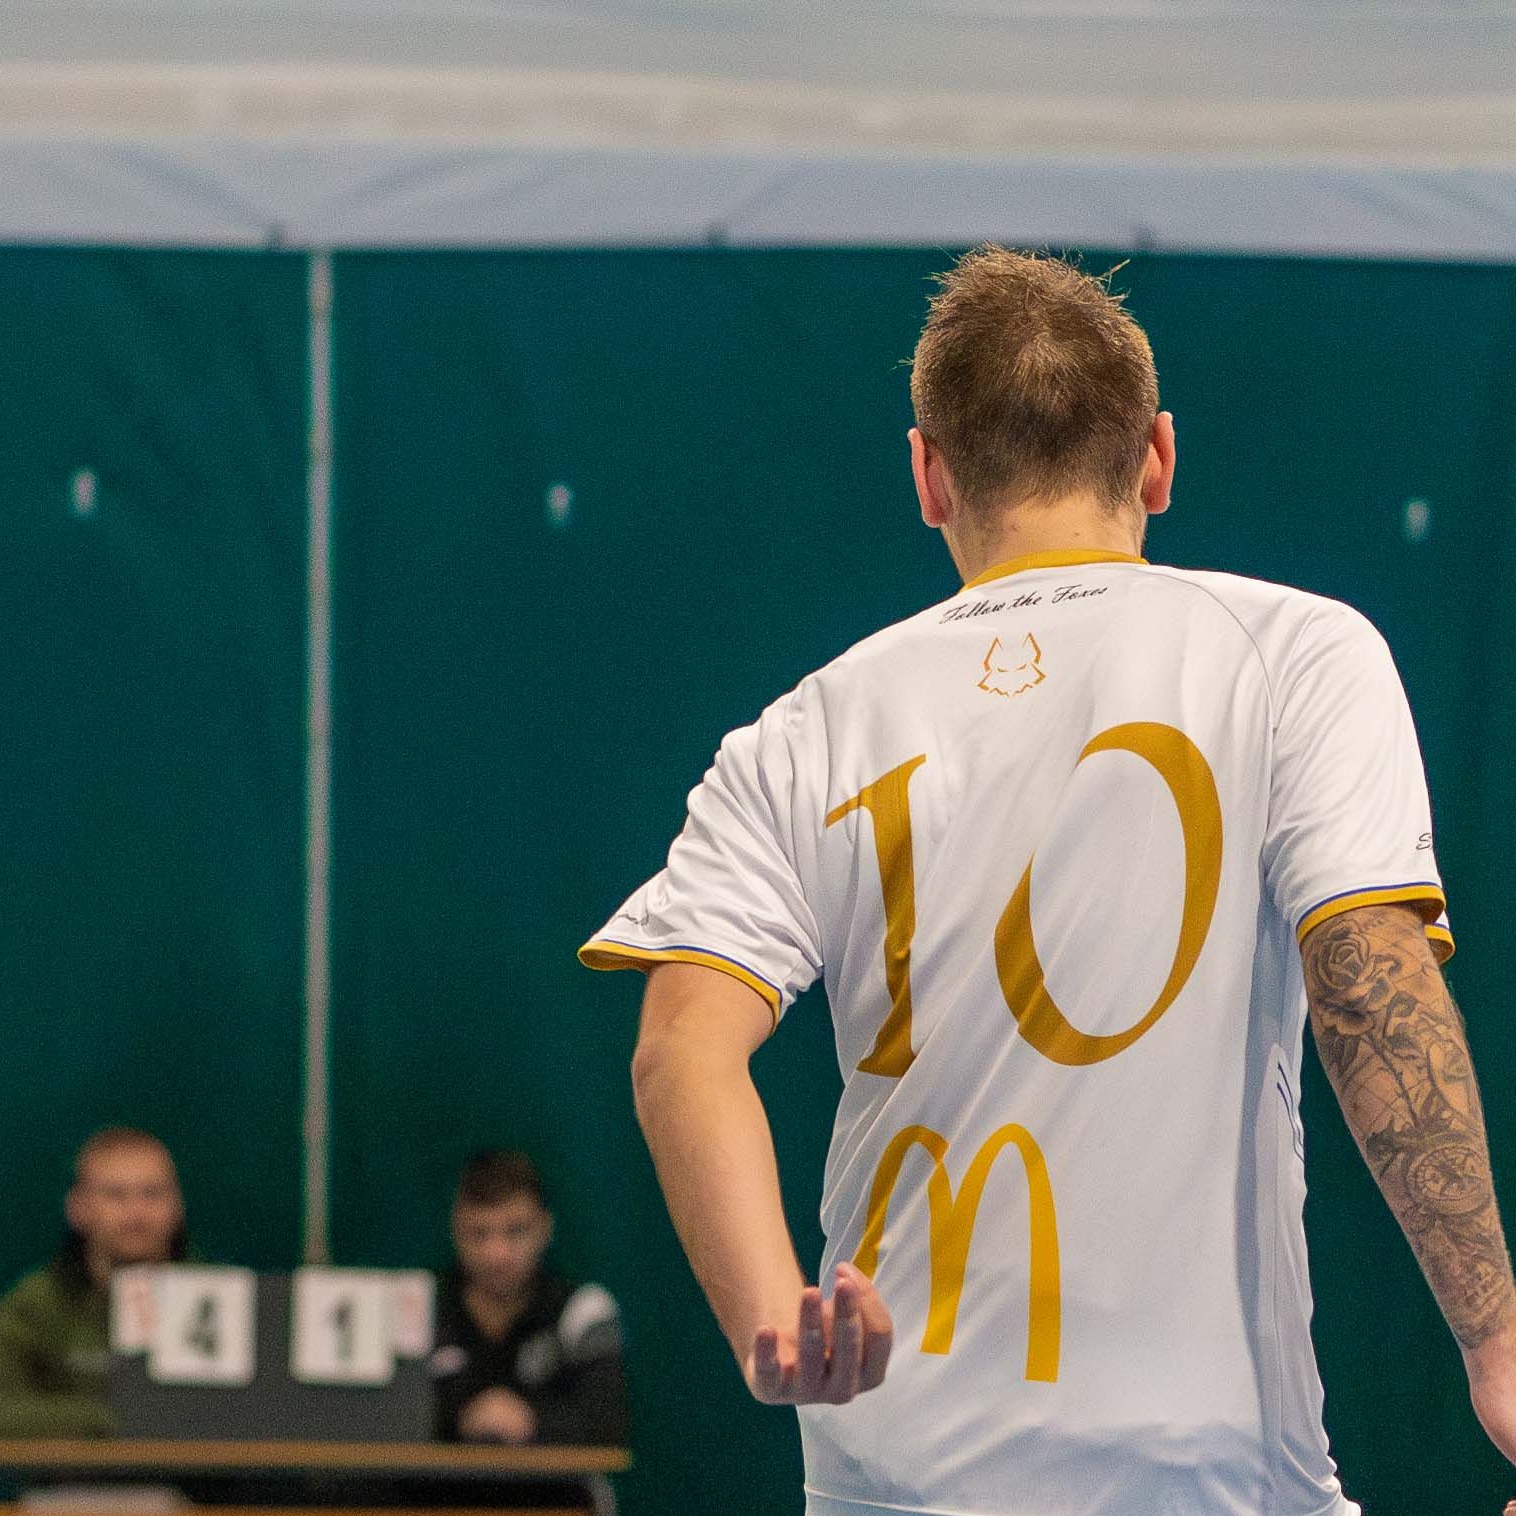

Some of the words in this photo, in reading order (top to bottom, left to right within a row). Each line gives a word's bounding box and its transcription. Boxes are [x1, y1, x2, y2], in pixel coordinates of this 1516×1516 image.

[939, 600, 1006, 624] Follow
[1008, 591, 1043, 610] the
[1052, 584, 1108, 604] Foxes
[825, 721, 1224, 1079] 10
[183, 1294, 220, 1362] 4
